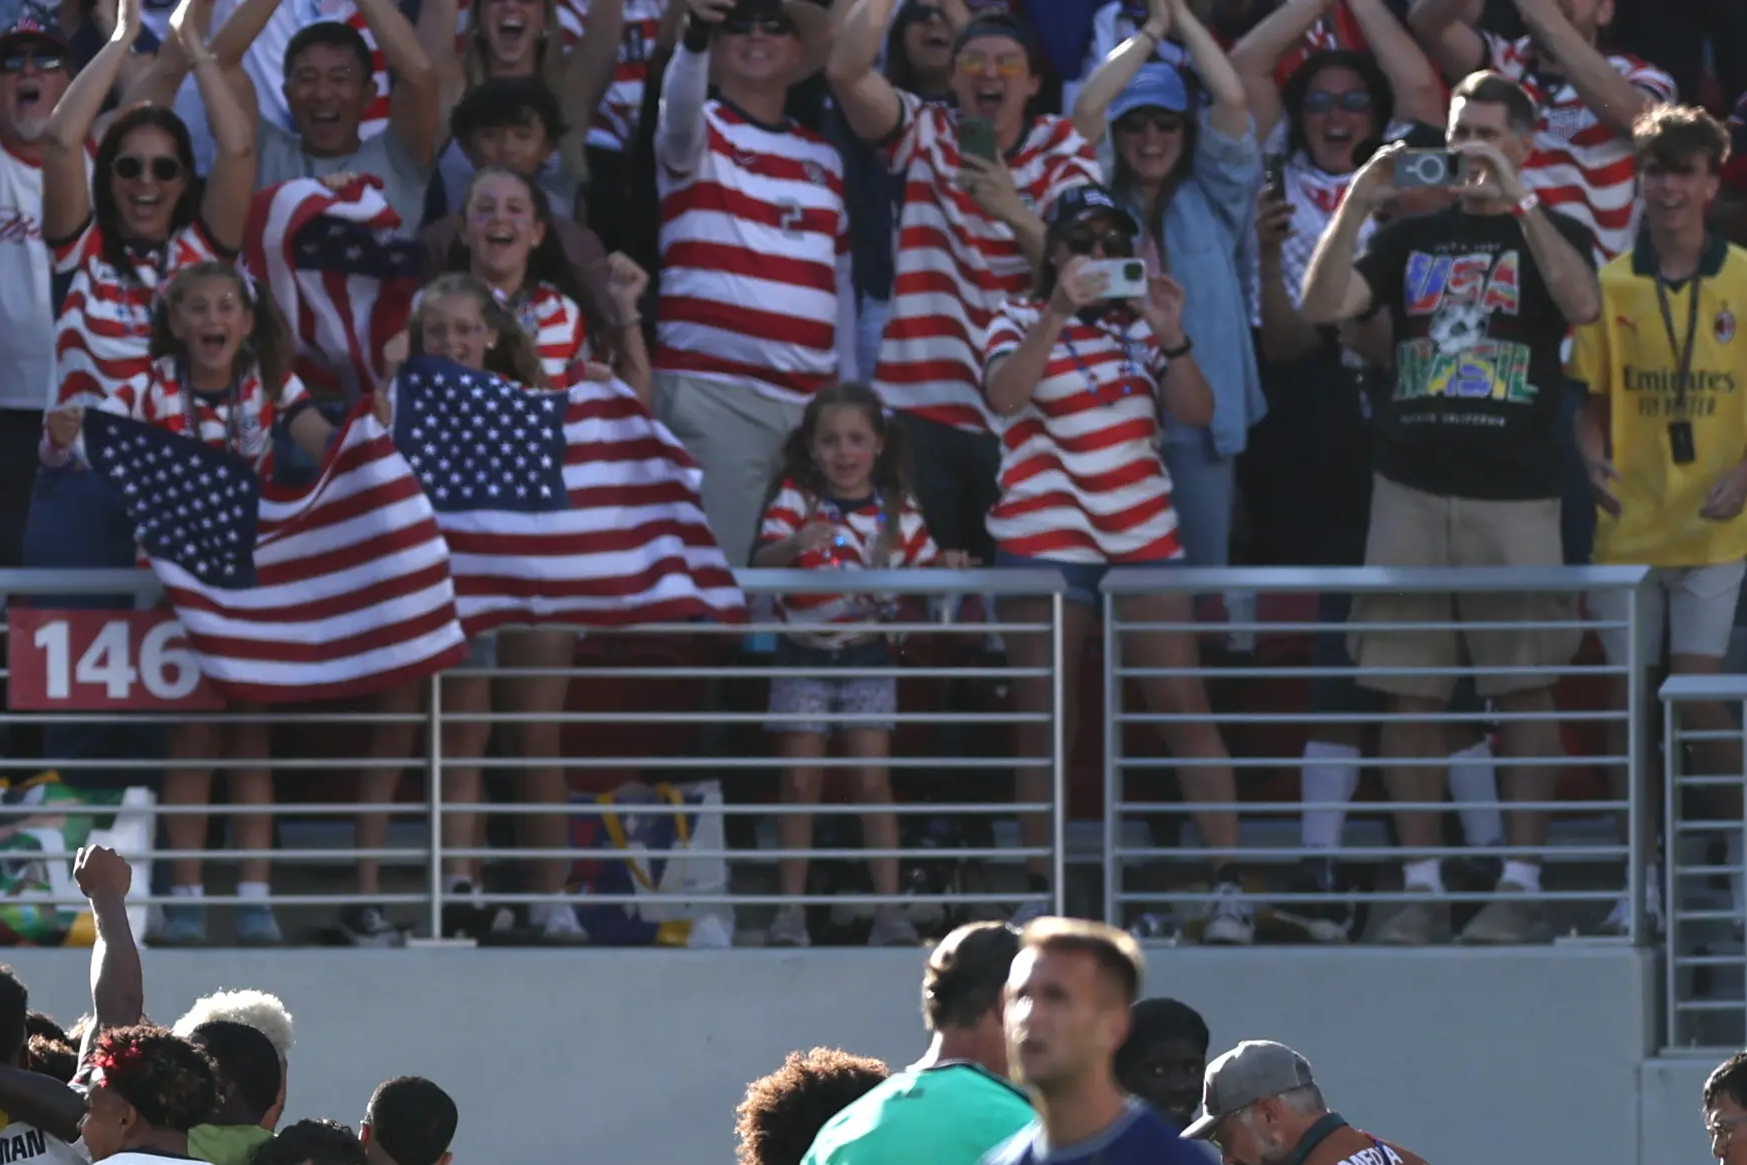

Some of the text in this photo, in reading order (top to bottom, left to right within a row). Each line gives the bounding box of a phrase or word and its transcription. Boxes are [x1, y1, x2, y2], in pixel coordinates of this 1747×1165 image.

[1405, 250, 1520, 316] USA
[1624, 364, 1736, 392] Emiates
[33, 620, 200, 700] 146
